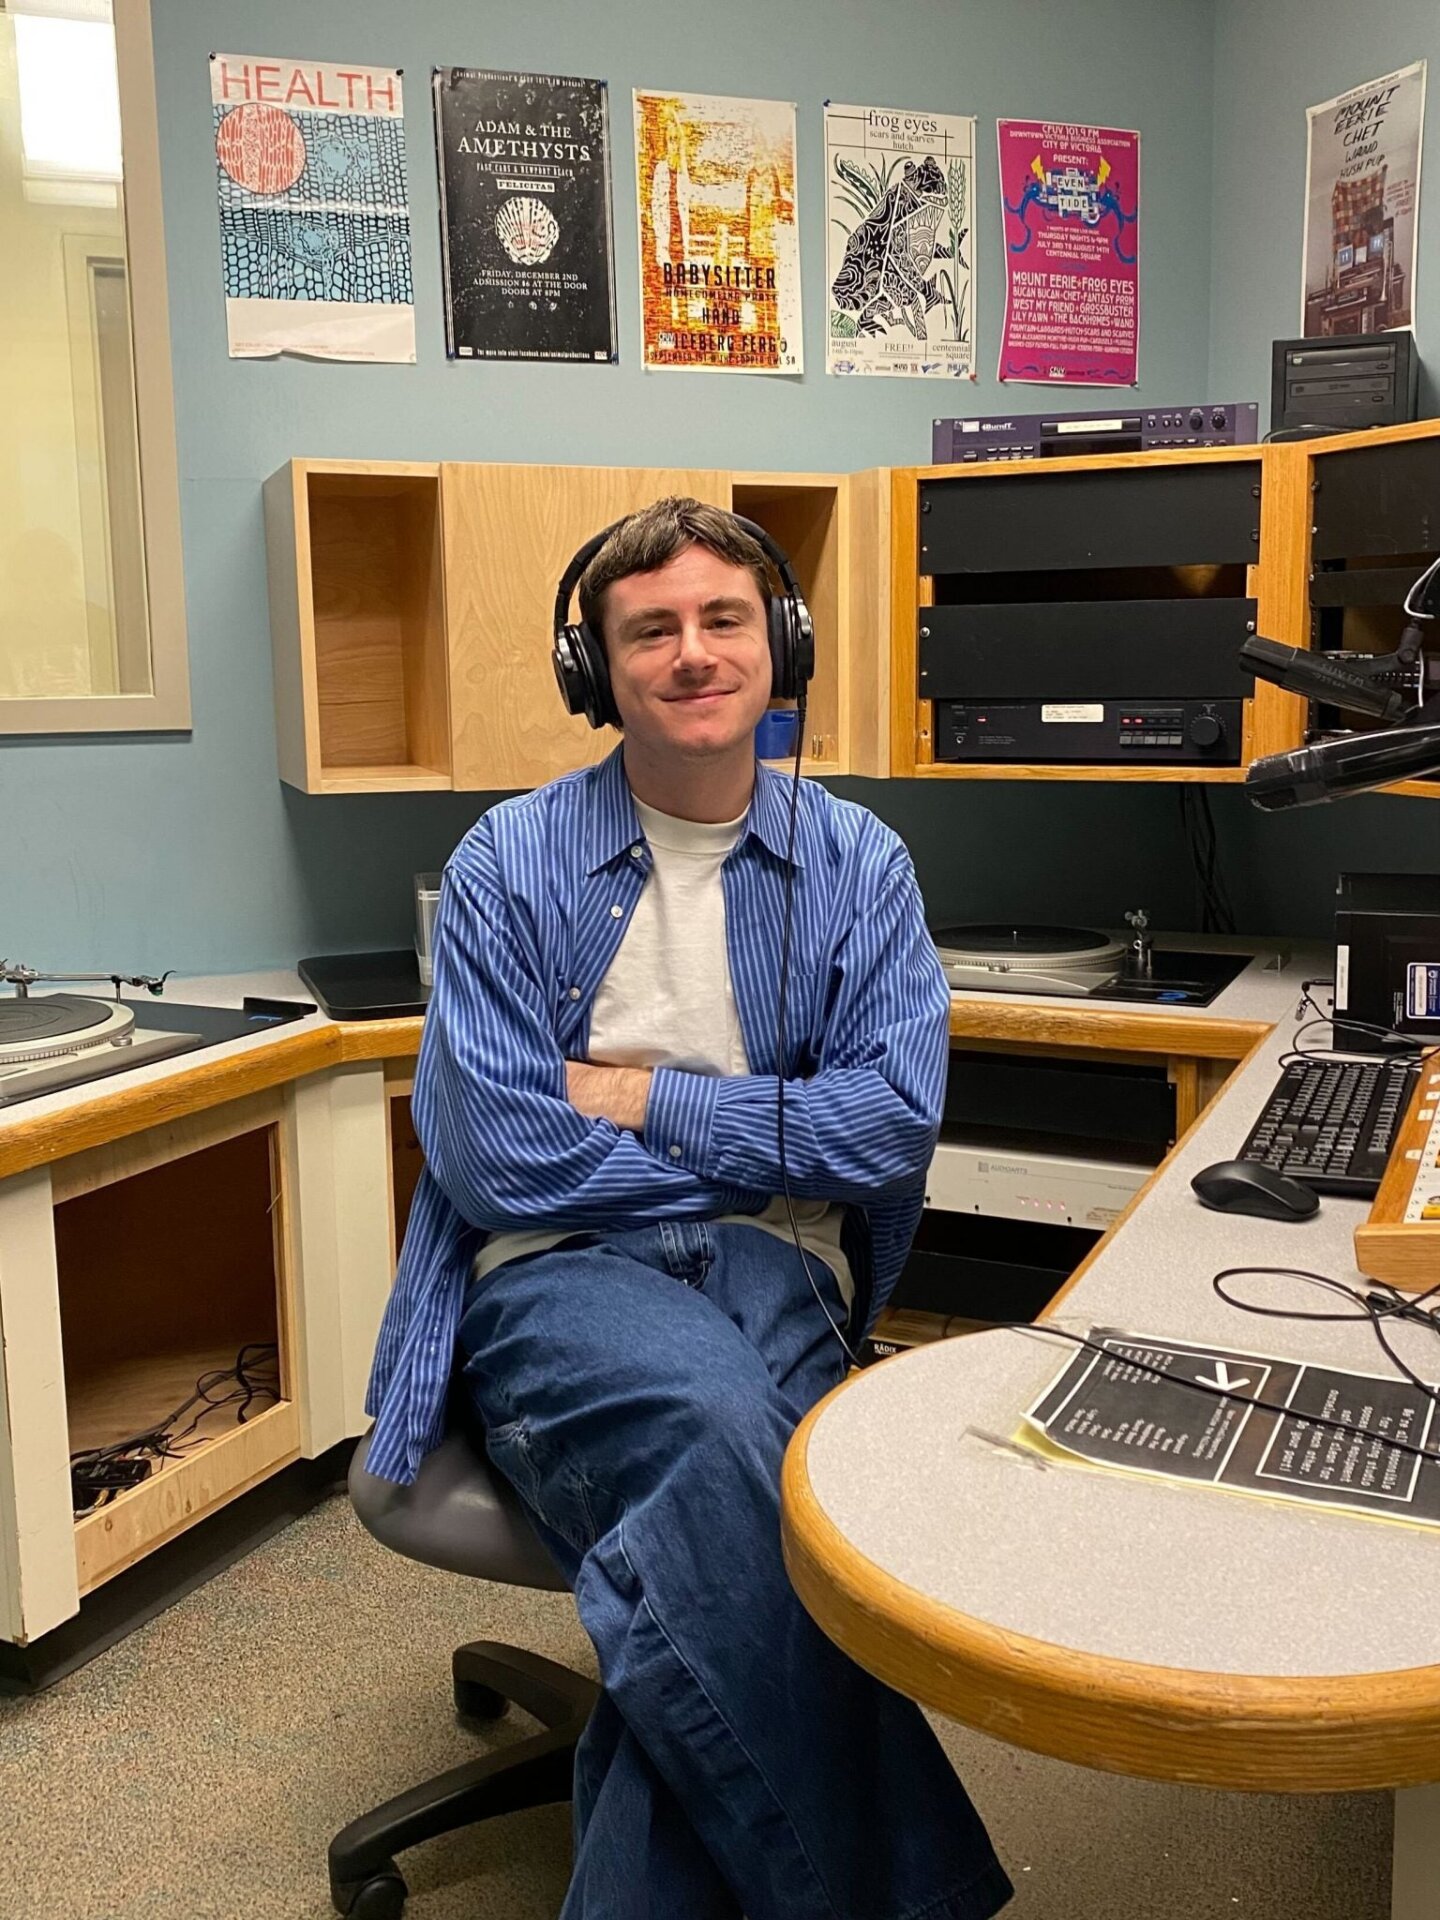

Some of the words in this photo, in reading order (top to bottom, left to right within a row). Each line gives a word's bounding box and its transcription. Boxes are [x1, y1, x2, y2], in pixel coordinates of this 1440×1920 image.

[221, 62, 394, 111] HEALTH
[1334, 85, 1400, 122] MOUNT
[869, 109, 900, 133] frog
[904, 118, 938, 136] eyes
[1334, 101, 1391, 135] EERIE
[475, 120, 521, 135] ADAM
[525, 124, 538, 136] &
[540, 124, 572, 139] THE
[869, 130, 889, 140] scars
[891, 131, 905, 141] and
[907, 133, 935, 144] scarves
[1042, 124, 1063, 135] CFUV
[1087, 129, 1100, 139] FM
[1343, 120, 1384, 147] CHET
[457, 136, 591, 161] AMETHYSTS
[893, 140, 914, 151] hutch
[1042, 139, 1059, 149] CITY
[1060, 141, 1068, 150] OF
[1070, 143, 1102, 154] VICTORIA
[1053, 153, 1089, 165] PRESENT:
[498, 181, 554, 191] FELICITAS
[1057, 177, 1084, 188] EVEN
[1060, 197, 1088, 207] TIDE
[1037, 231, 1068, 241] THURSDAY
[1045, 249, 1079, 259] CENTENNIAL
[480, 270, 514, 280] FRIDAY,
[515, 271, 560, 281] DECEMBER
[562, 273, 579, 281] 2ND
[663, 262, 777, 289] BABYSITTER
[1012, 271, 1047, 287] MOUNT
[1049, 274, 1077, 290] EERIE
[1082, 277, 1107, 292] FROG
[1110, 279, 1134, 295] EYES
[472, 278, 520, 288] ADMISSION
[545, 281, 562, 289] THE
[564, 282, 588, 290] DOOR
[501, 287, 530, 297] DOORS
[532, 289, 543, 297] AT
[1063, 291, 1081, 301] CHET
[1083, 292, 1113, 304] FANTASY
[1115, 295, 1134, 306] PROM
[1013, 298, 1034, 310] WEST
[1035, 300, 1047, 311] MY
[1048, 302, 1075, 313] FRIEND
[1079, 303, 1134, 317] GROSSBUSTER
[702, 307, 740, 325] HAND
[1011, 310, 1027, 321] LILY
[1027, 311, 1049, 322] FAWN
[1053, 314, 1068, 324] THE
[1113, 318, 1135, 329] WAND
[674, 332, 735, 352] ICEBERG
[831, 340, 857, 350] august
[932, 344, 970, 353] centennial
[945, 352, 970, 362] square
[990, 1163, 1028, 1175] AUDIOARTS
[1320, 1389, 1339, 1420] ourselve
[1378, 1416, 1393, 1429] for
[1288, 1431, 1302, 1449] your
[1325, 1442, 1342, 1464] clean
[1319, 1466, 1335, 1480] for
[1360, 1460, 1379, 1487] studio
[1381, 1447, 1402, 1490] esponsible
